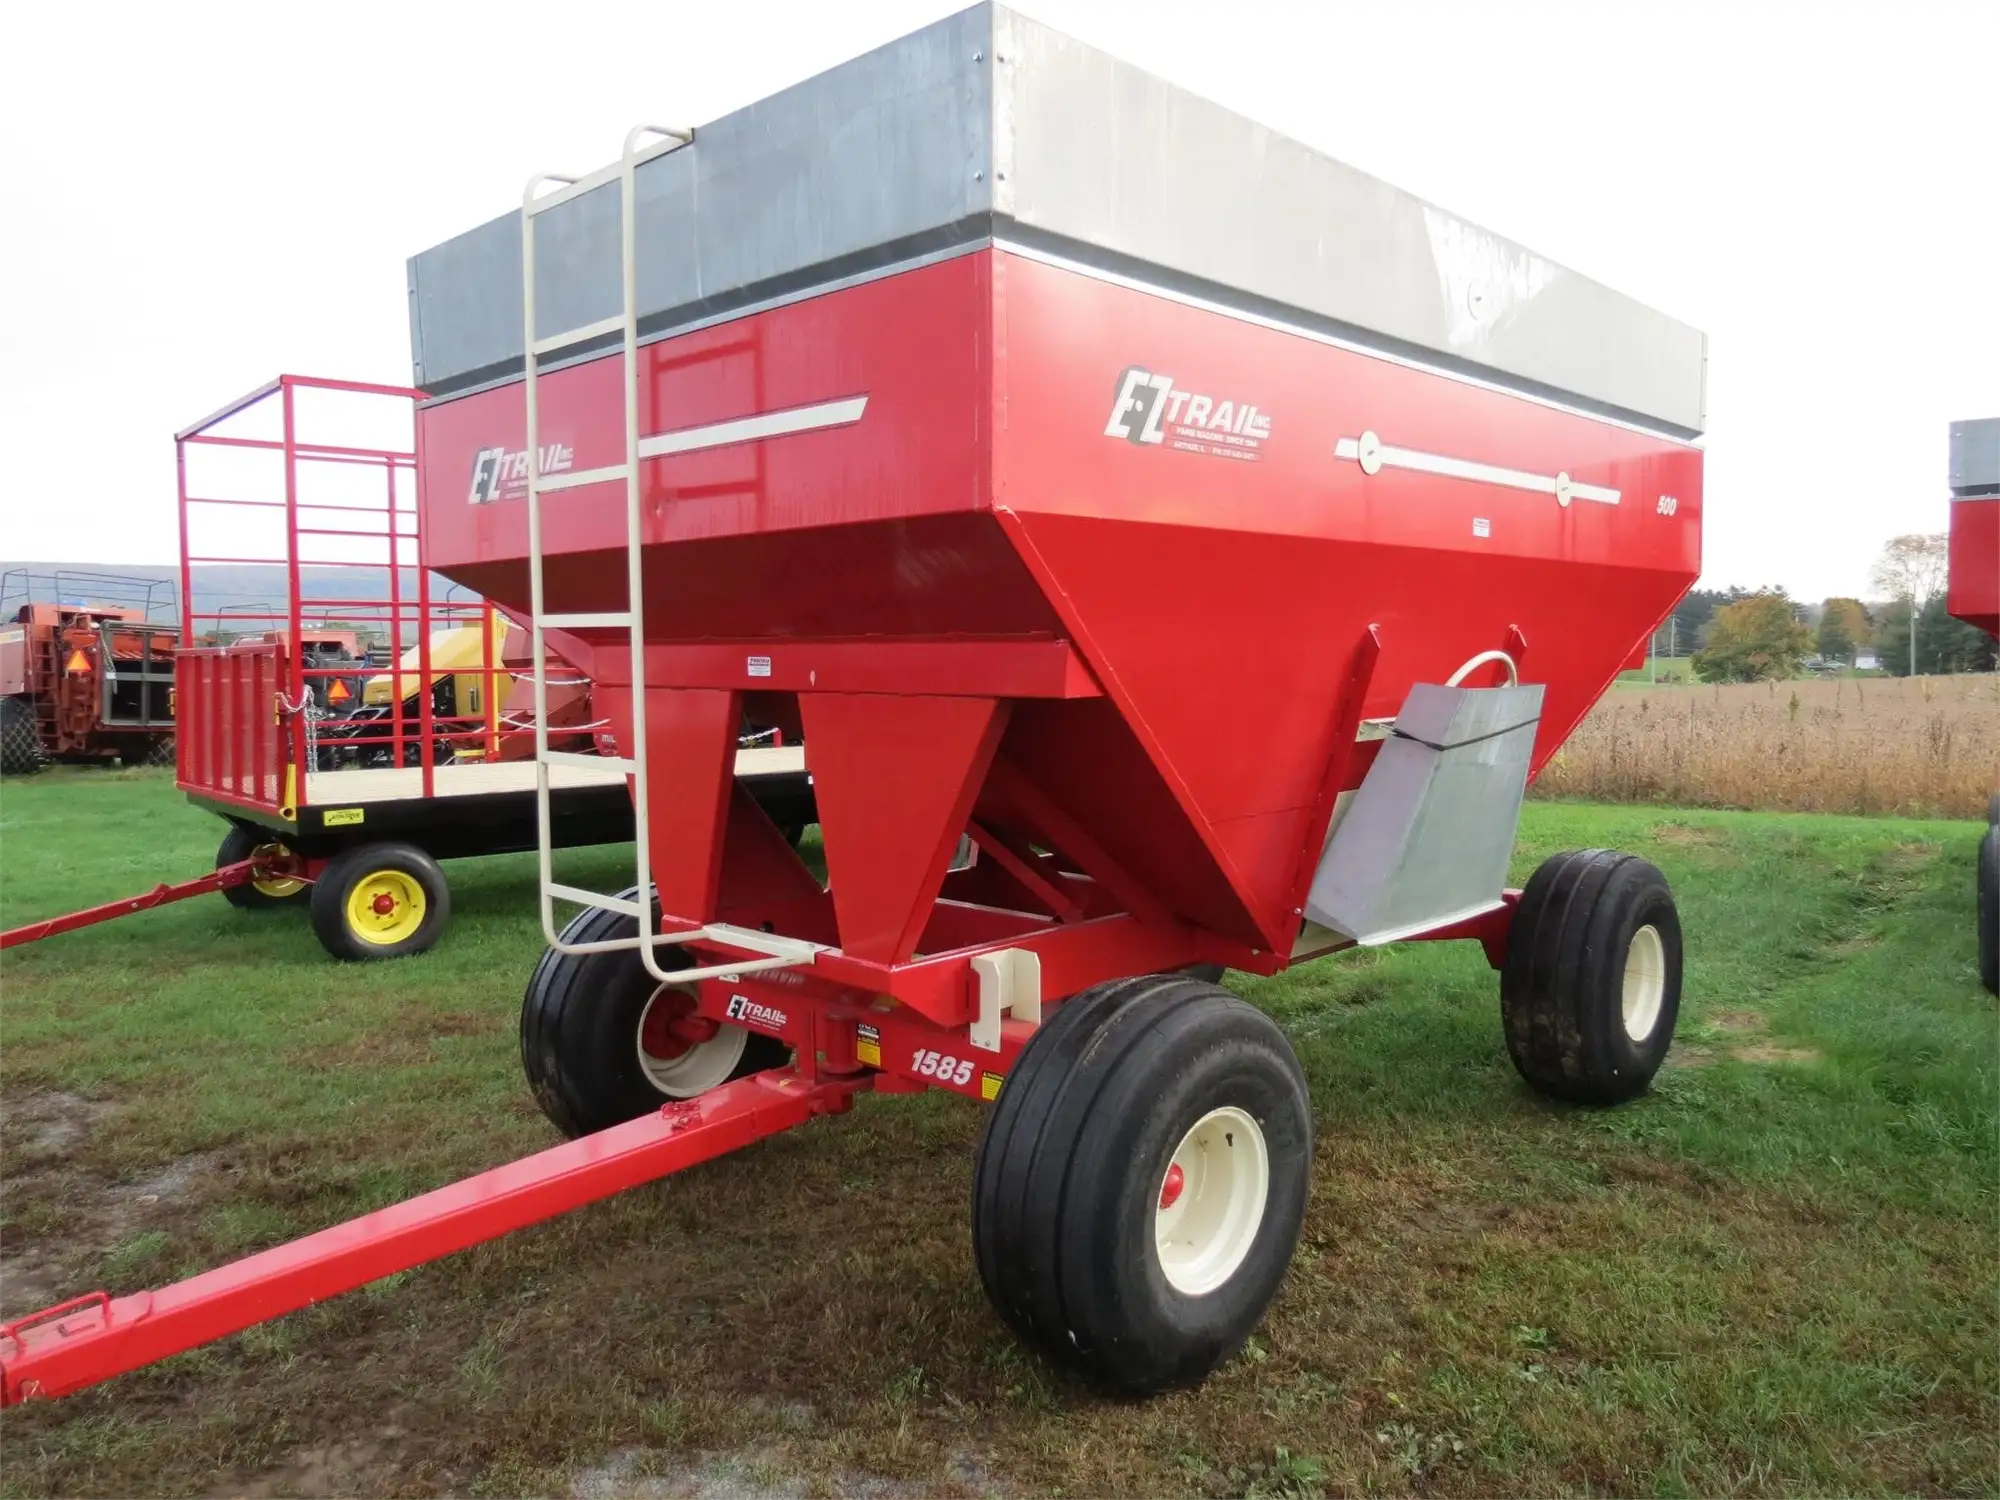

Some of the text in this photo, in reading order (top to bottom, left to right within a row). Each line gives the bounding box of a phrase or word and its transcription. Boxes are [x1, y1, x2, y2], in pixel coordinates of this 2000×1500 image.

[1168, 390, 1269, 439] TRAIL
[746, 1002, 786, 1024] TRAIL
[911, 1048, 976, 1086] 1585
